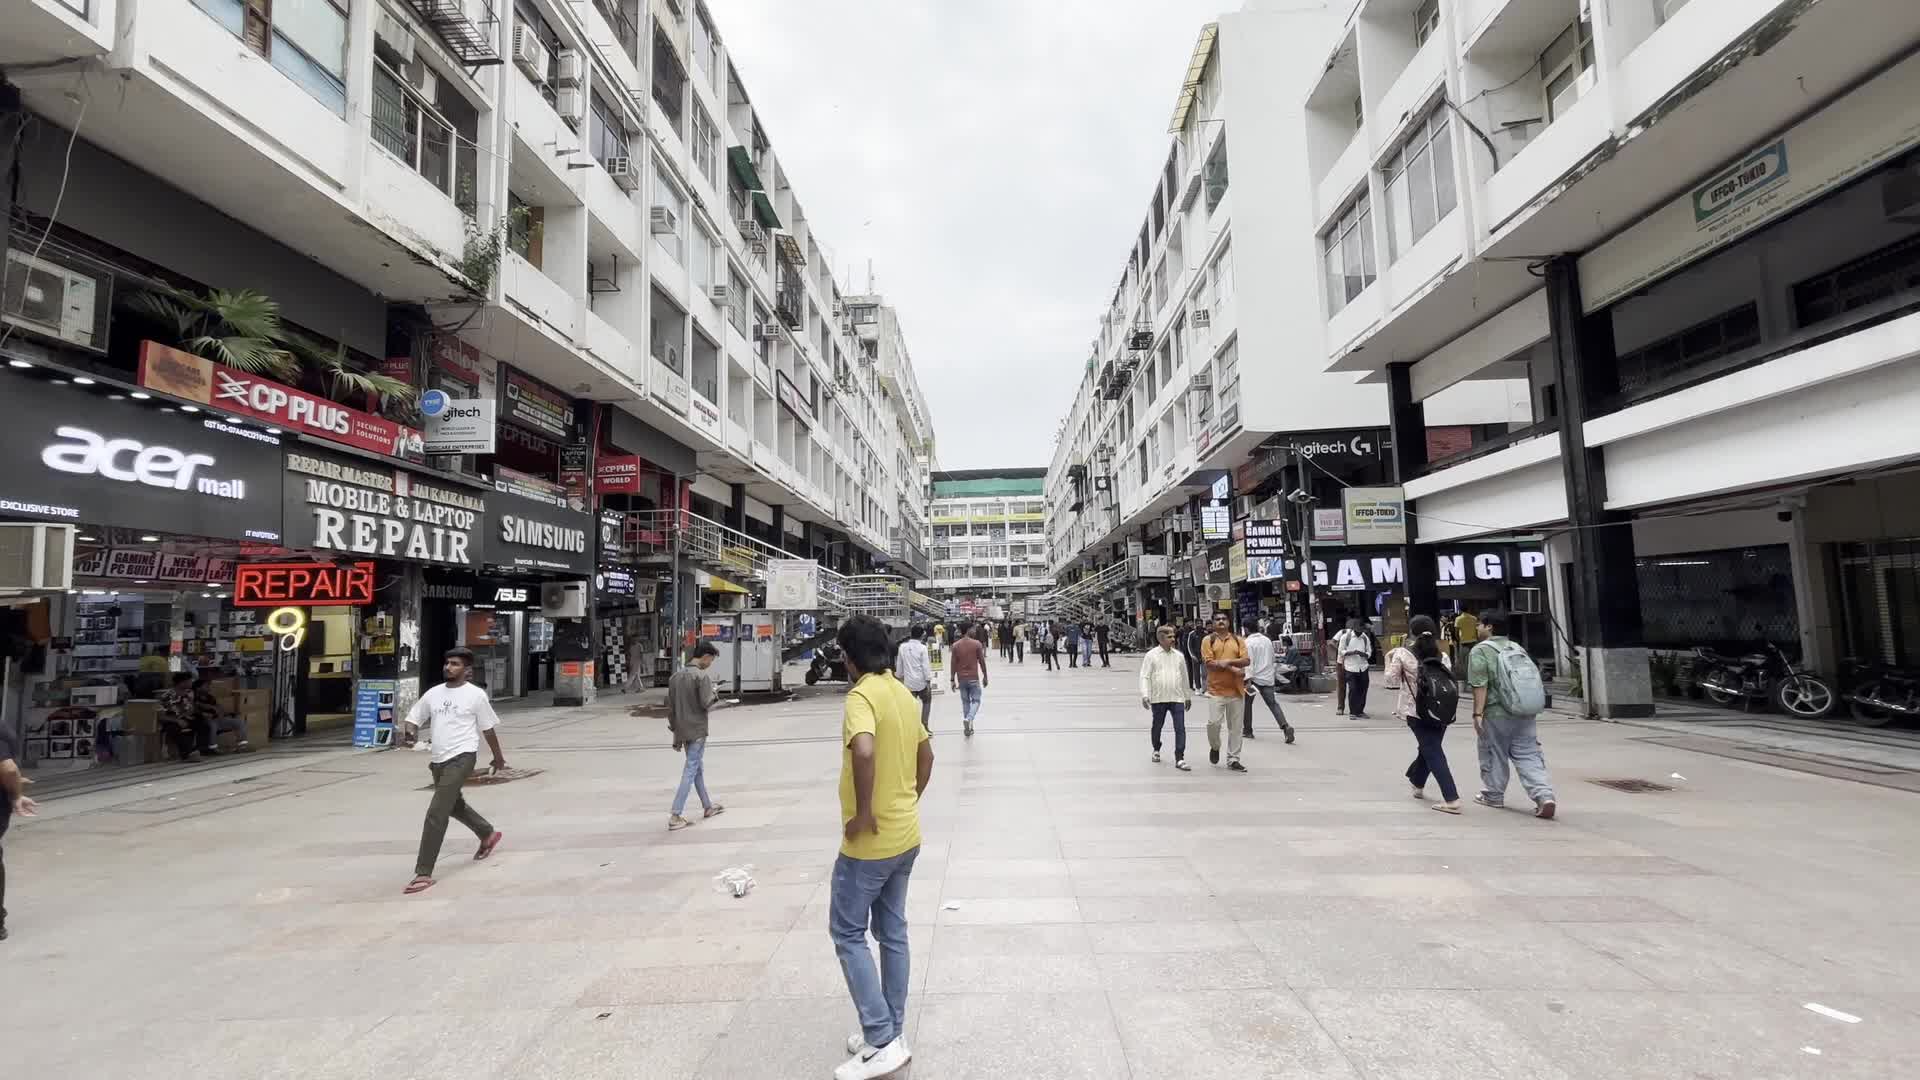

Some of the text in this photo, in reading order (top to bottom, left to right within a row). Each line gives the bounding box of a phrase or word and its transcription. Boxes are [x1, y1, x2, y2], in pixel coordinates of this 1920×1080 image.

[1711, 161, 1766, 204] IFFCO-TOKIO
[251, 383, 350, 435] CP PLUS
[442, 406, 481, 422] gitech
[356, 420, 388, 435] SECURITY
[356, 429, 391, 446] SOLUTIONS
[41, 425, 245, 499] acer mall
[605, 463, 637, 473] CP PLUS
[287, 453, 393, 492] REPAIR MASTER
[603, 476, 631, 485] WORLD
[0, 500, 80, 518] EXCLUSIVE STORE
[305, 478, 475, 531] MOBILE & LAPTOP
[1355, 508, 1396, 517] IFFCO-TOKIO
[313, 507, 470, 565] REPAIR
[502, 514, 585, 553] SAMSUNG
[1246, 526, 1282, 537] GAMING
[1247, 537, 1283, 548] PC WALA
[115, 551, 156, 564] GAMING
[173, 557, 200, 569] NEW
[110, 564, 155, 577] PC BUILT
[161, 566, 203, 579] LAPTOP
[1301, 552, 1503, 587] GAMNG
[239, 569, 370, 599] REPAIR
[422, 584, 473, 600] SAMSUNG
[494, 587, 528, 602] ASUS
